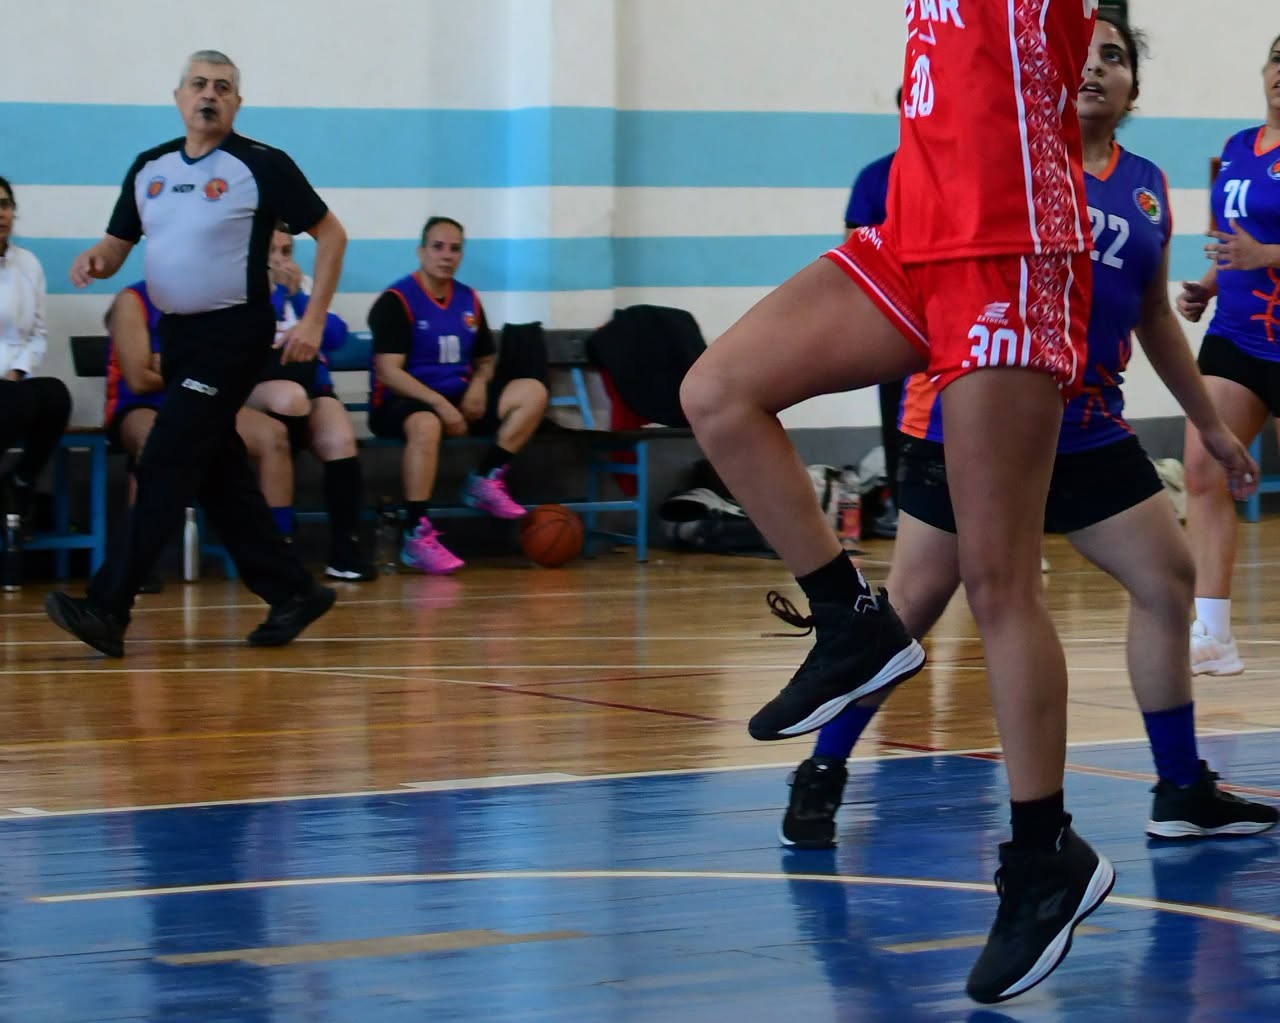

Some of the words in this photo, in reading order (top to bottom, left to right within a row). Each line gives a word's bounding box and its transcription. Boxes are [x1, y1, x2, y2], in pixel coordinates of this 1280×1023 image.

[1223, 179, 1252, 218] 21
[1086, 205, 1130, 269] 22
[961, 323, 1018, 367] 30
